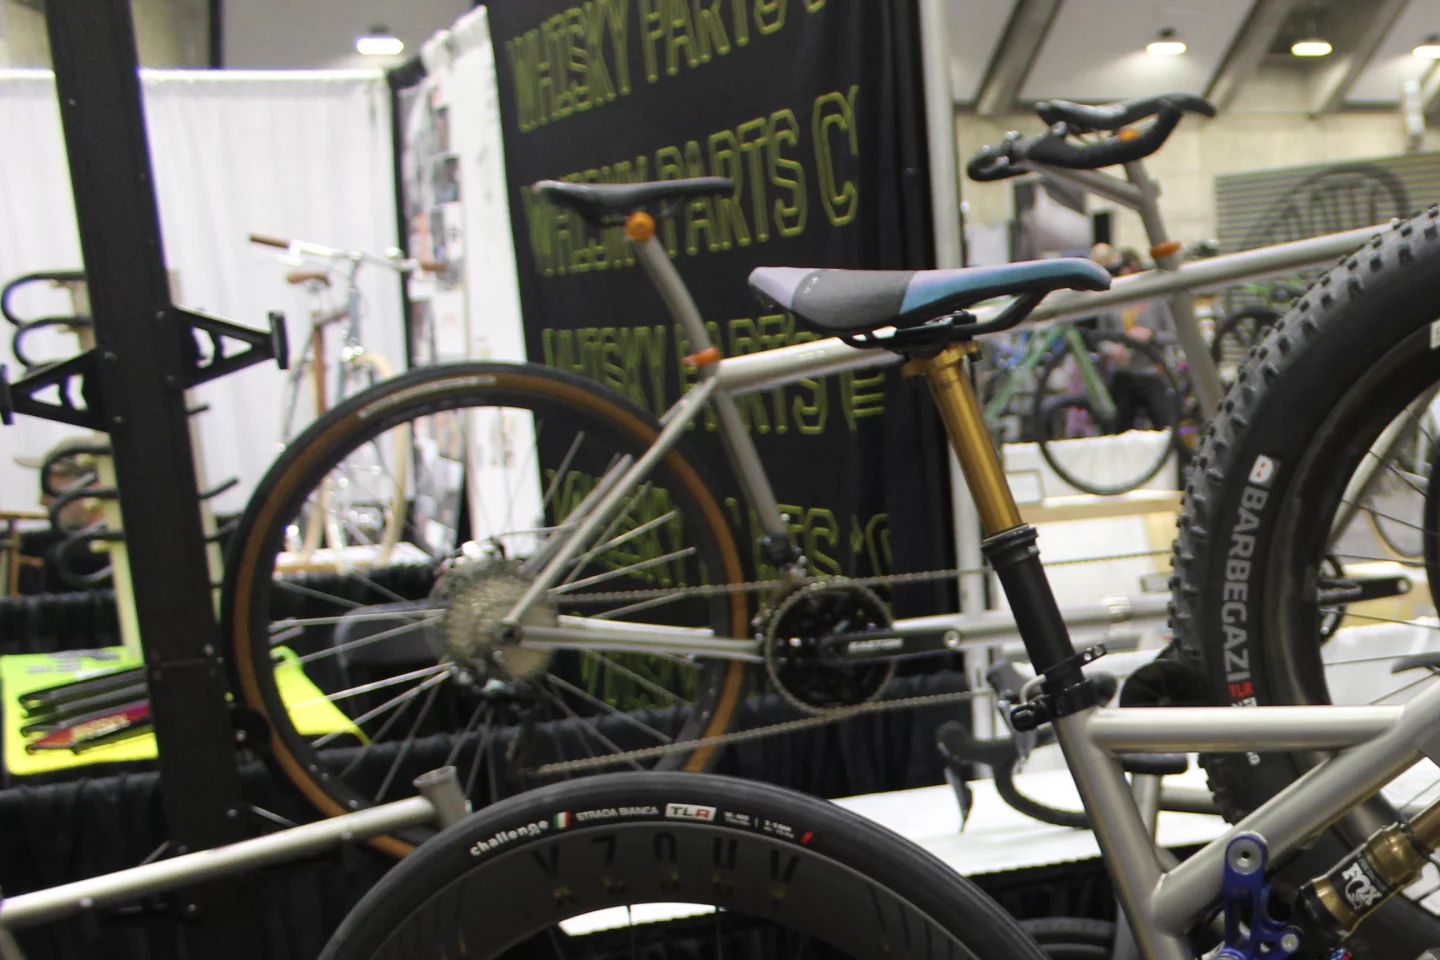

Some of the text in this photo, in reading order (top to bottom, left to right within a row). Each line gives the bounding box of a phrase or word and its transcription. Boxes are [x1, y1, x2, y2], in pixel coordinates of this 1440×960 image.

[1220, 485, 1269, 682] BARBEGAZI
[576, 807, 618, 822] STRADA
[619, 805, 660, 817] BIANCA
[670, 805, 711, 819] TLR
[470, 819, 549, 857] challenge
[1342, 862, 1383, 907] FOX
